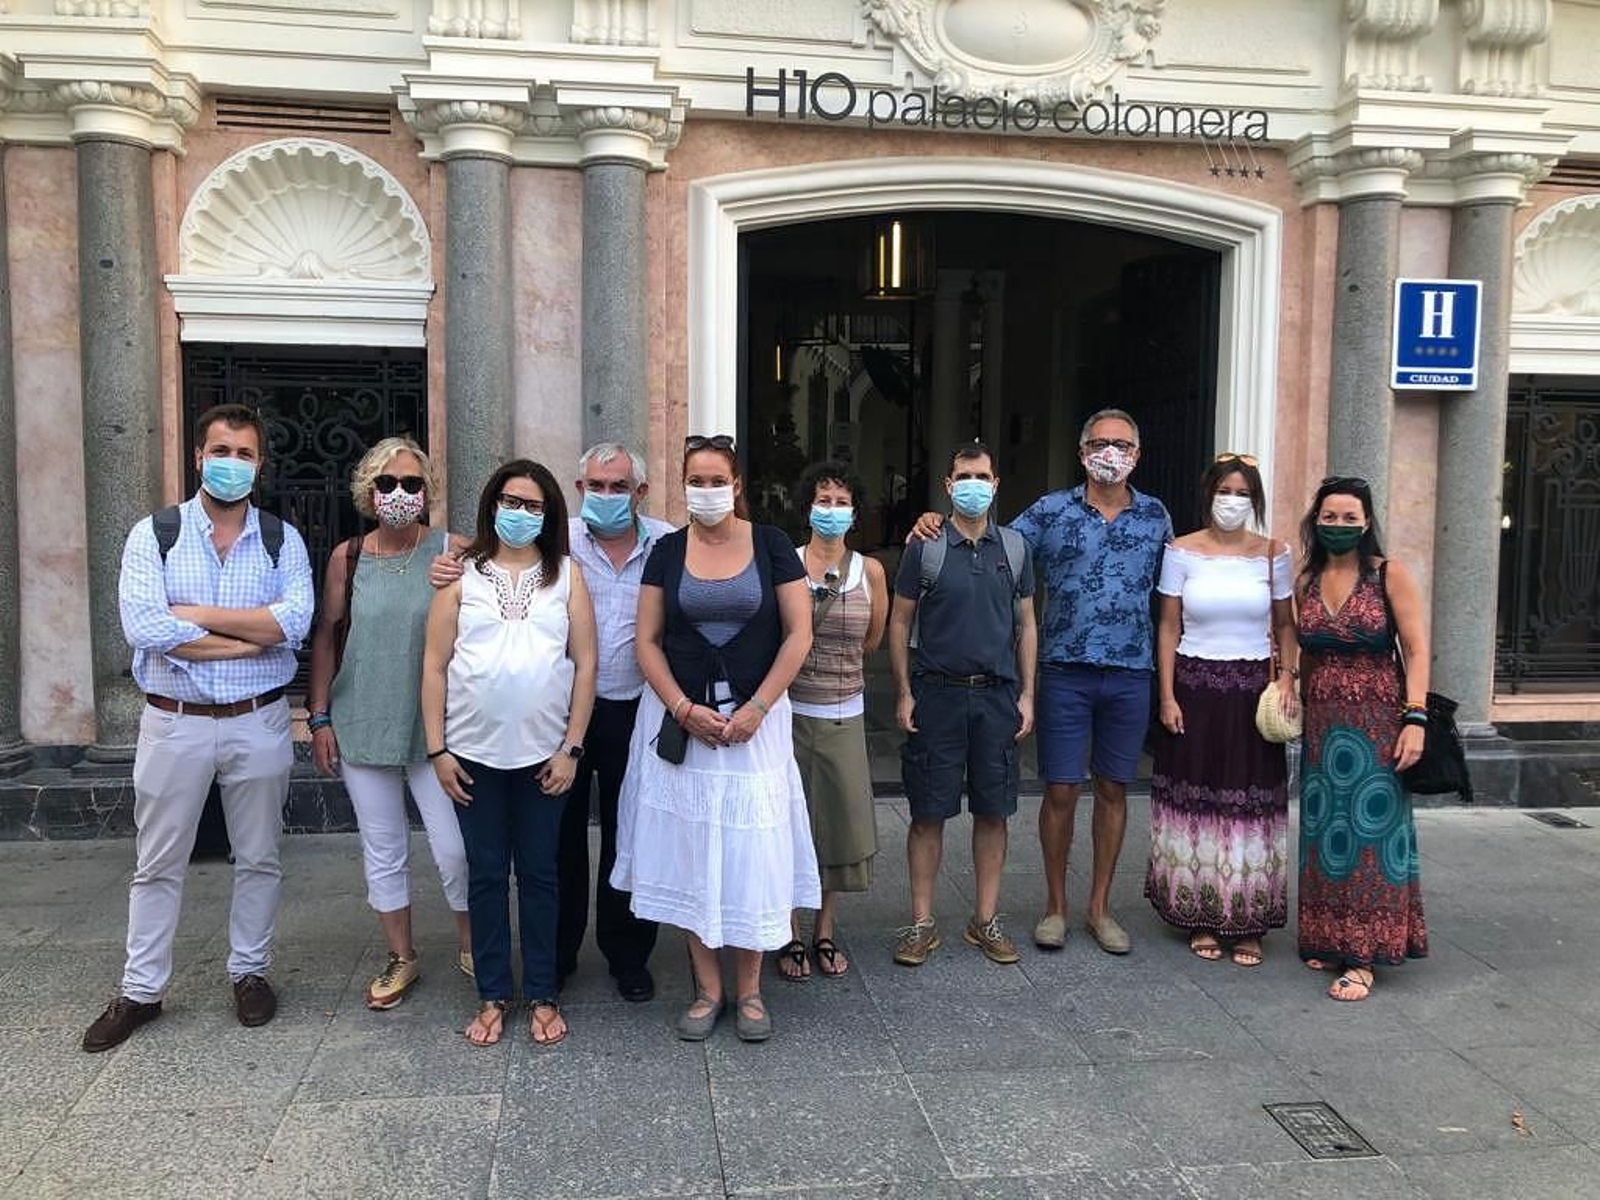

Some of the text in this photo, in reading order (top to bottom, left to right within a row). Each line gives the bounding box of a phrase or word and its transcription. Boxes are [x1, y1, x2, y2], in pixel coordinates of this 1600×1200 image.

[867, 84, 1042, 132] palacio
[1052, 93, 1270, 142] colomera
[1419, 290, 1457, 338] H
[1409, 374, 1460, 384] CIUDAD
